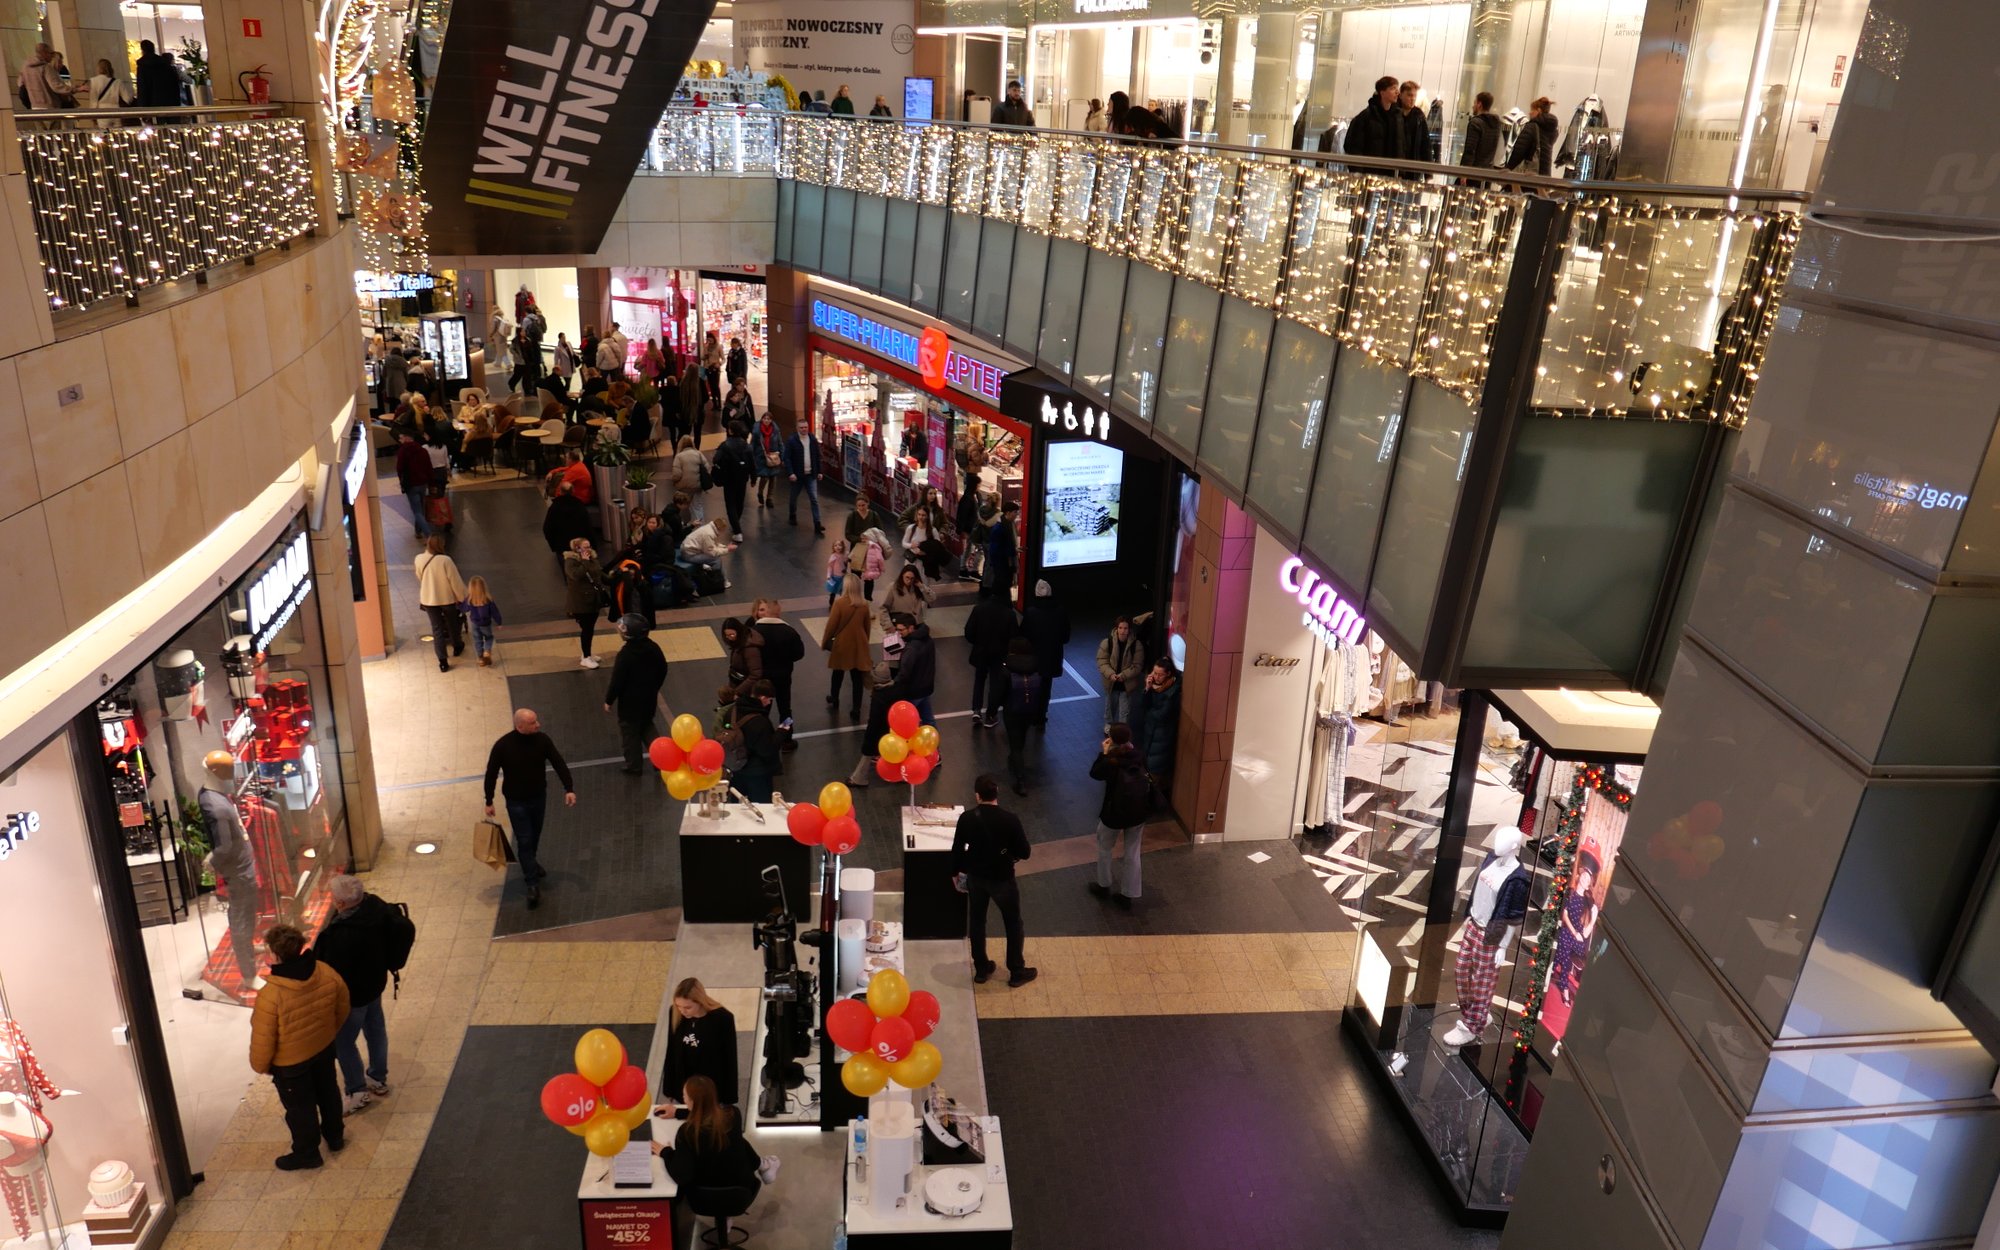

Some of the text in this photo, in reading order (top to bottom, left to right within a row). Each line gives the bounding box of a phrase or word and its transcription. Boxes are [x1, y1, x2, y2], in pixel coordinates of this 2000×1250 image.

[786, 19, 883, 35] NOWOCZESNY
[473, 35, 570, 173] WELL
[813, 299, 918, 367] SUPER-PHARM
[593, 1211, 660, 1219] Świąteczne Okazje
[607, 1230, 651, 1243] -45%
